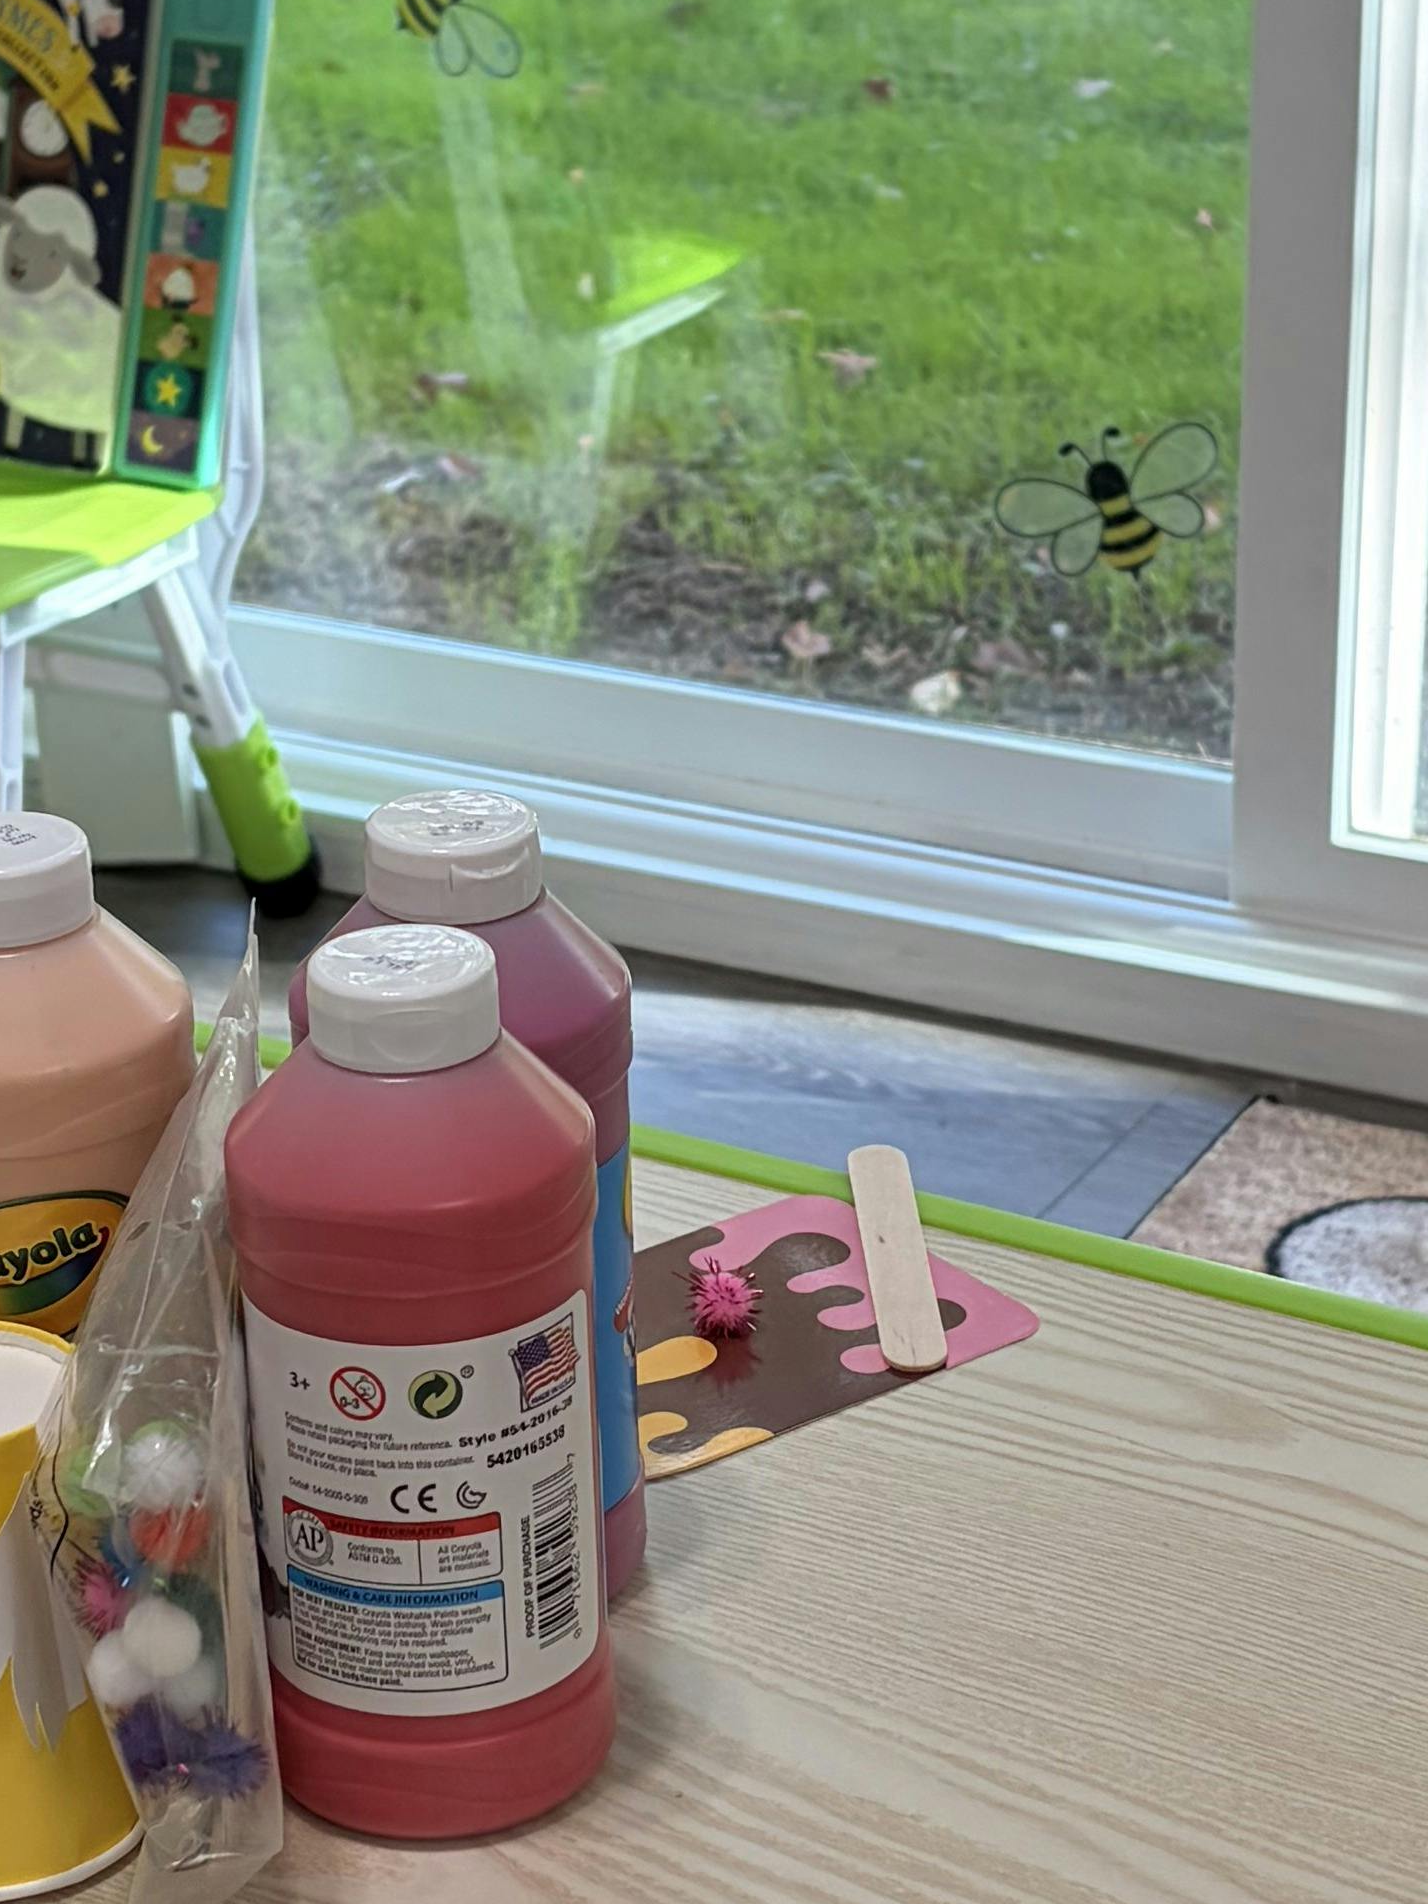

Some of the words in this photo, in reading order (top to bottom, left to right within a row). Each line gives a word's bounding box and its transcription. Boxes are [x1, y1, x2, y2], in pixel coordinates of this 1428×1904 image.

[289, 1371, 310, 1391] 3+
[459, 1433, 496, 1449] Style
[487, 1424, 566, 1468] 5420165538
[391, 1483, 438, 1513] CE
[295, 1522, 324, 1553] AP
[372, 1525, 455, 1538] INFORMATION
[521, 1515, 532, 1577] PURCHASE
[438, 1555, 450, 1564] art
[439, 1565, 452, 1573] are
[304, 1579, 350, 1599] WASHING
[353, 1590, 362, 1600] &
[363, 1592, 393, 1602] CARE
[395, 1589, 478, 1604] INFORMATION
[524, 1580, 533, 1596] OF
[524, 1598, 535, 1639] PROOF
